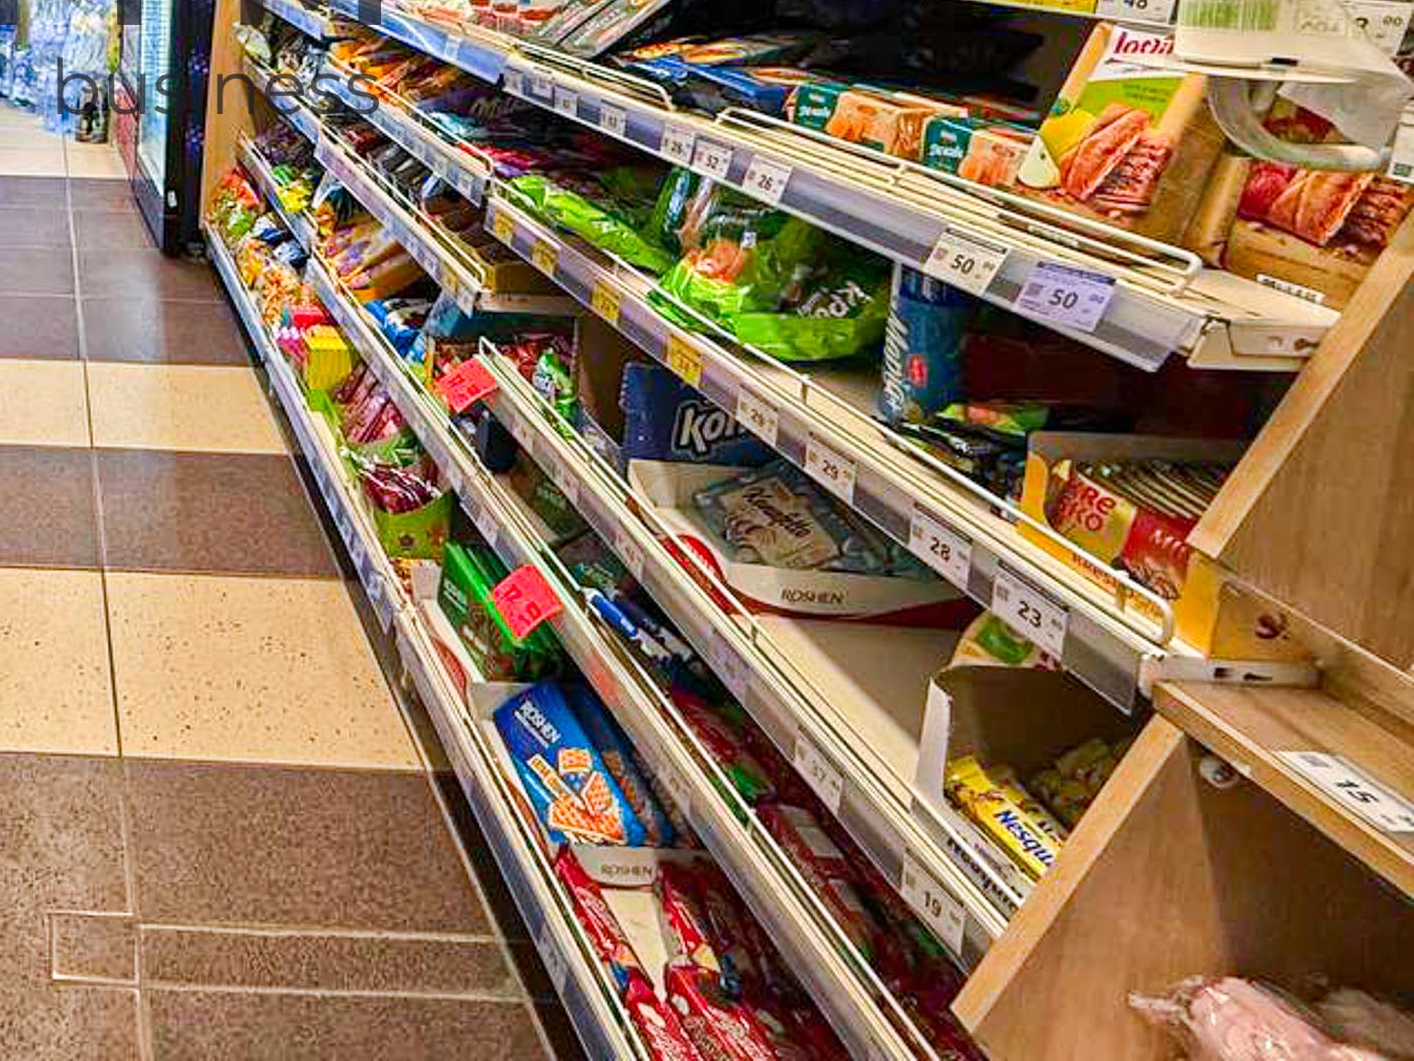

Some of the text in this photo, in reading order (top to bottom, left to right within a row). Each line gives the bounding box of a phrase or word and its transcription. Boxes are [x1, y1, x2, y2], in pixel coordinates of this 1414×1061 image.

[950, 253, 975, 275] 50
[1049, 288, 1079, 312] 50
[929, 539, 951, 561] 28
[1018, 600, 1042, 629] 23
[518, 700, 562, 744] ROSHEN
[1336, 776, 1379, 807] 15
[922, 889, 943, 919] 19
